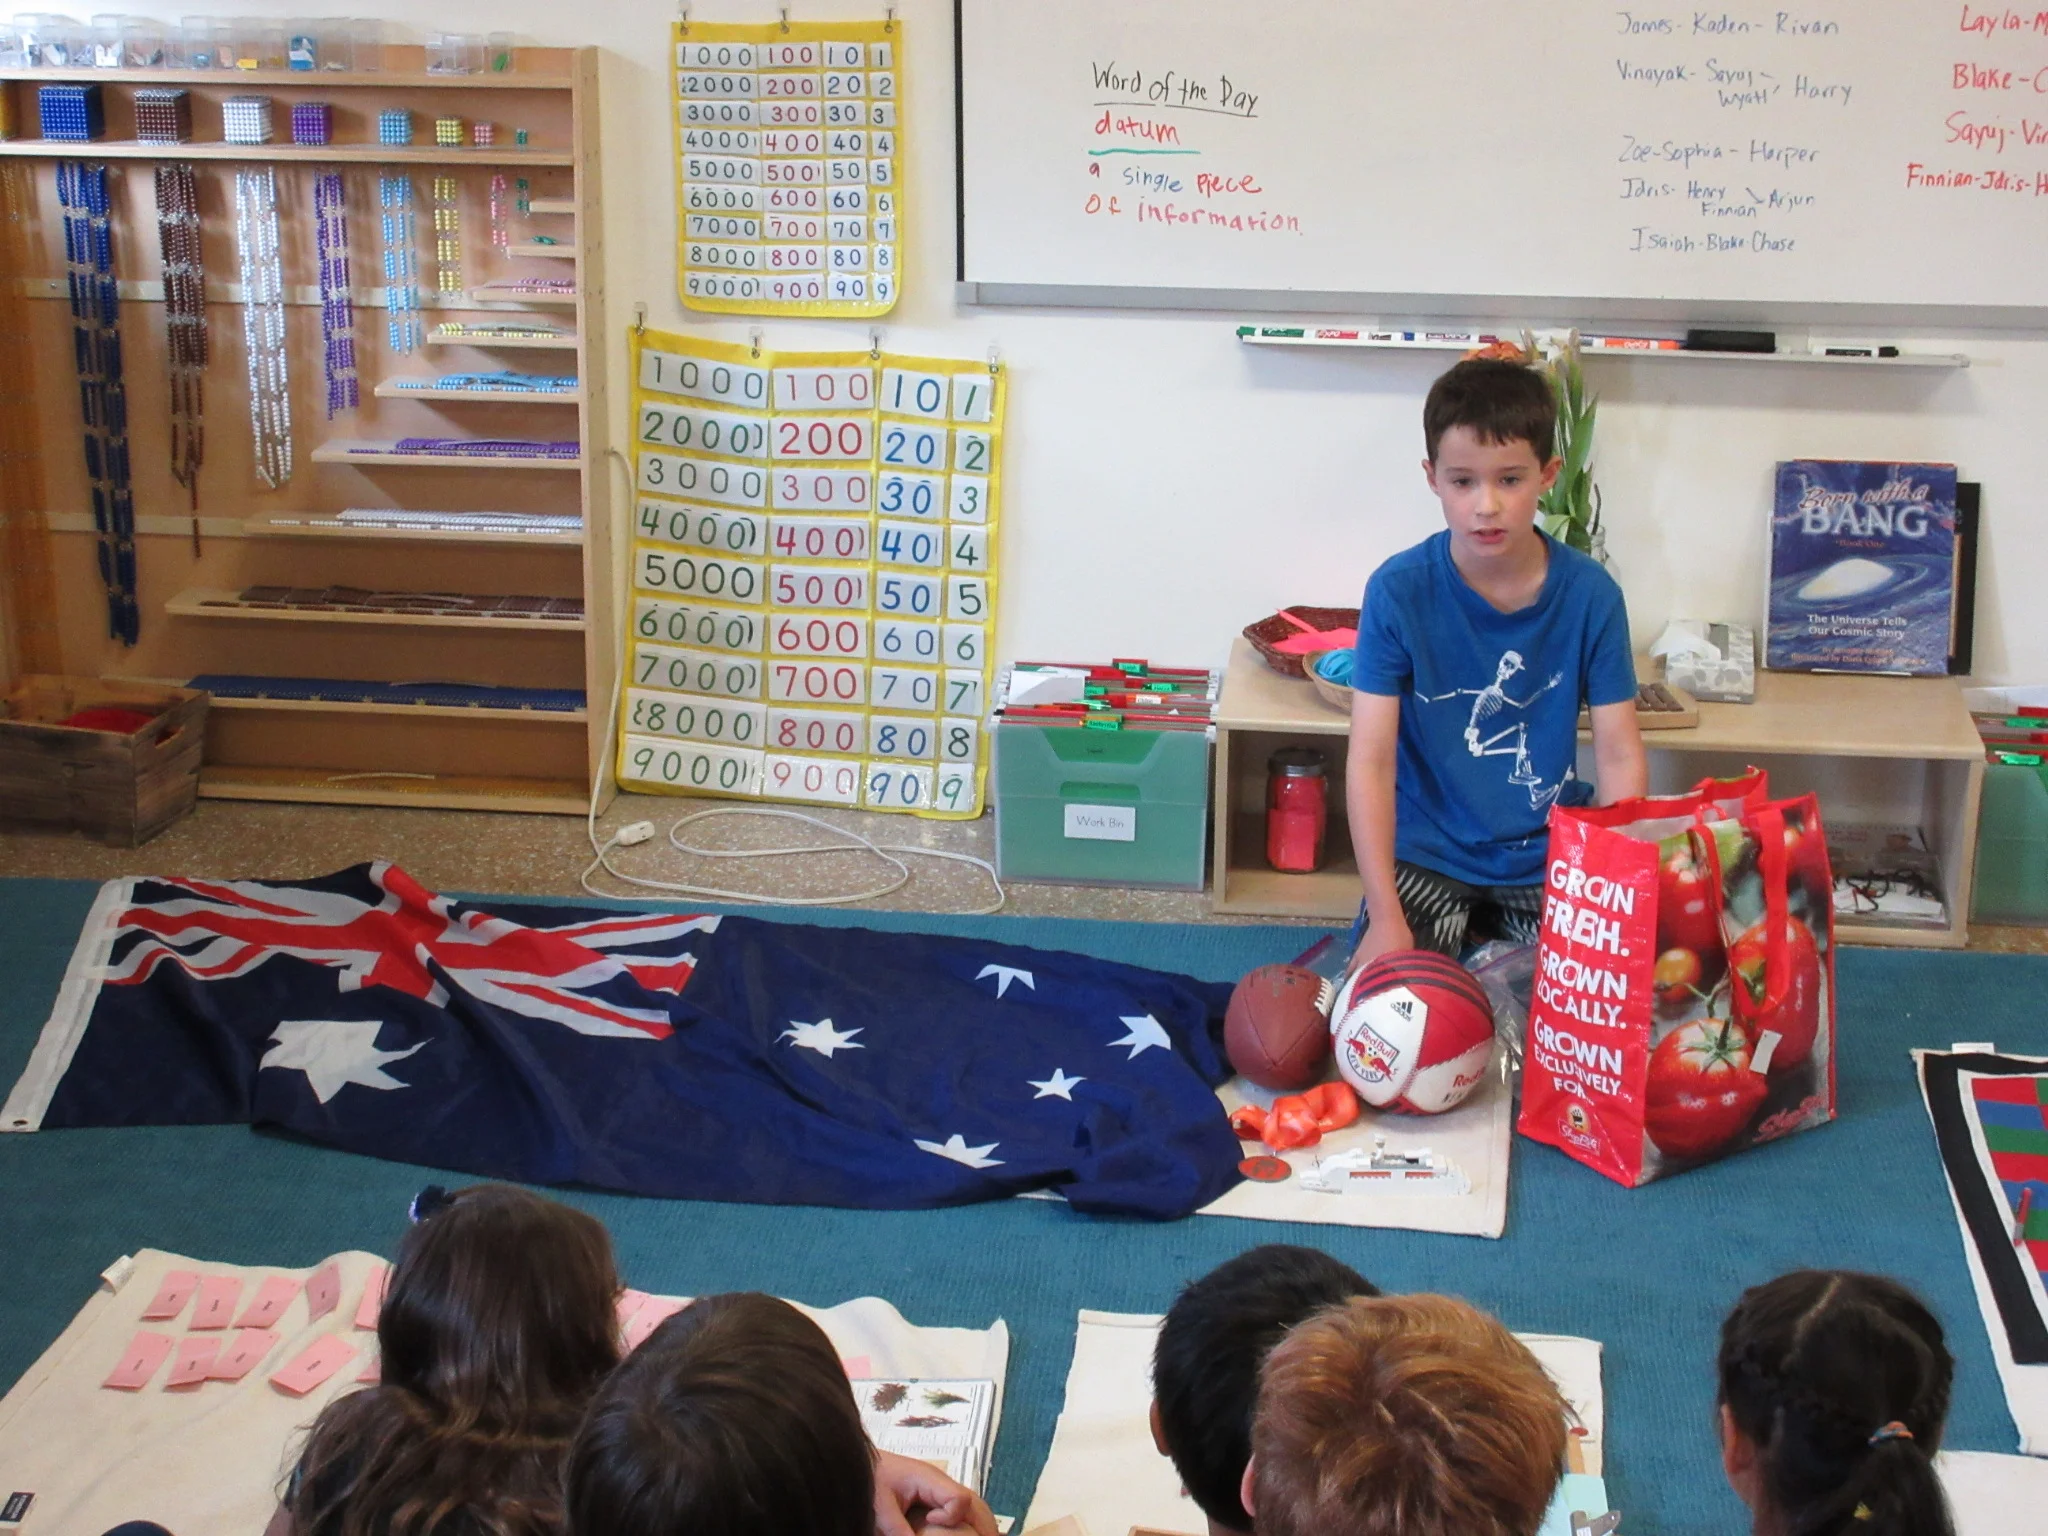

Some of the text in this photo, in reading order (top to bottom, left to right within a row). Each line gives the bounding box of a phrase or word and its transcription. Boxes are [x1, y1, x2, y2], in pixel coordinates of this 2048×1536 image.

[681, 46, 751, 66] 1000
[768, 47, 812, 64] 100
[828, 46, 859, 65] 10
[688, 75, 892, 95] 2000 200 20 2
[1093, 61, 1141, 93] Word
[1178, 79, 1207, 105] the
[1220, 75, 1258, 117] Day
[688, 105, 884, 124] 3000 300 30 3
[1095, 110, 1180, 145] datum
[686, 131, 889, 152] 4000 400 40 4
[690, 160, 887, 181] 5000 500 50 5
[1089, 163, 1100, 177] a
[1123, 166, 1183, 192] single
[690, 189, 889, 211] 6000 600 60 6
[693, 217, 889, 239] 7000 700 70 7
[691, 246, 889, 266] 8000 800 80 8
[689, 278, 888, 300] 9000 900 90 9
[654, 355, 763, 400] 1000
[786, 373, 869, 402] 100
[897, 373, 940, 412] 10
[644, 412, 985, 470] 2000 200 20 2
[646, 458, 978, 514] 3000 300 30 3
[641, 505, 979, 565] 4000 400 40 4
[1802, 504, 1928, 538] BANG
[645, 555, 982, 615] 5000 500 50 5
[640, 610, 975, 660] 6000 600 60 6
[1807, 614, 1907, 625] The Universe Tells
[1809, 626, 1905, 639] Our Cosmic Story
[640, 654, 971, 710] 7000 700 70 7
[647, 702, 970, 758] 8000 800 80 8
[633, 748, 962, 810] 9000 900 90 9
[1077, 816, 1123, 828] Work Bin
[1541, 943, 1627, 1000] GROWN
[1534, 1015, 1621, 1076] GROWN
